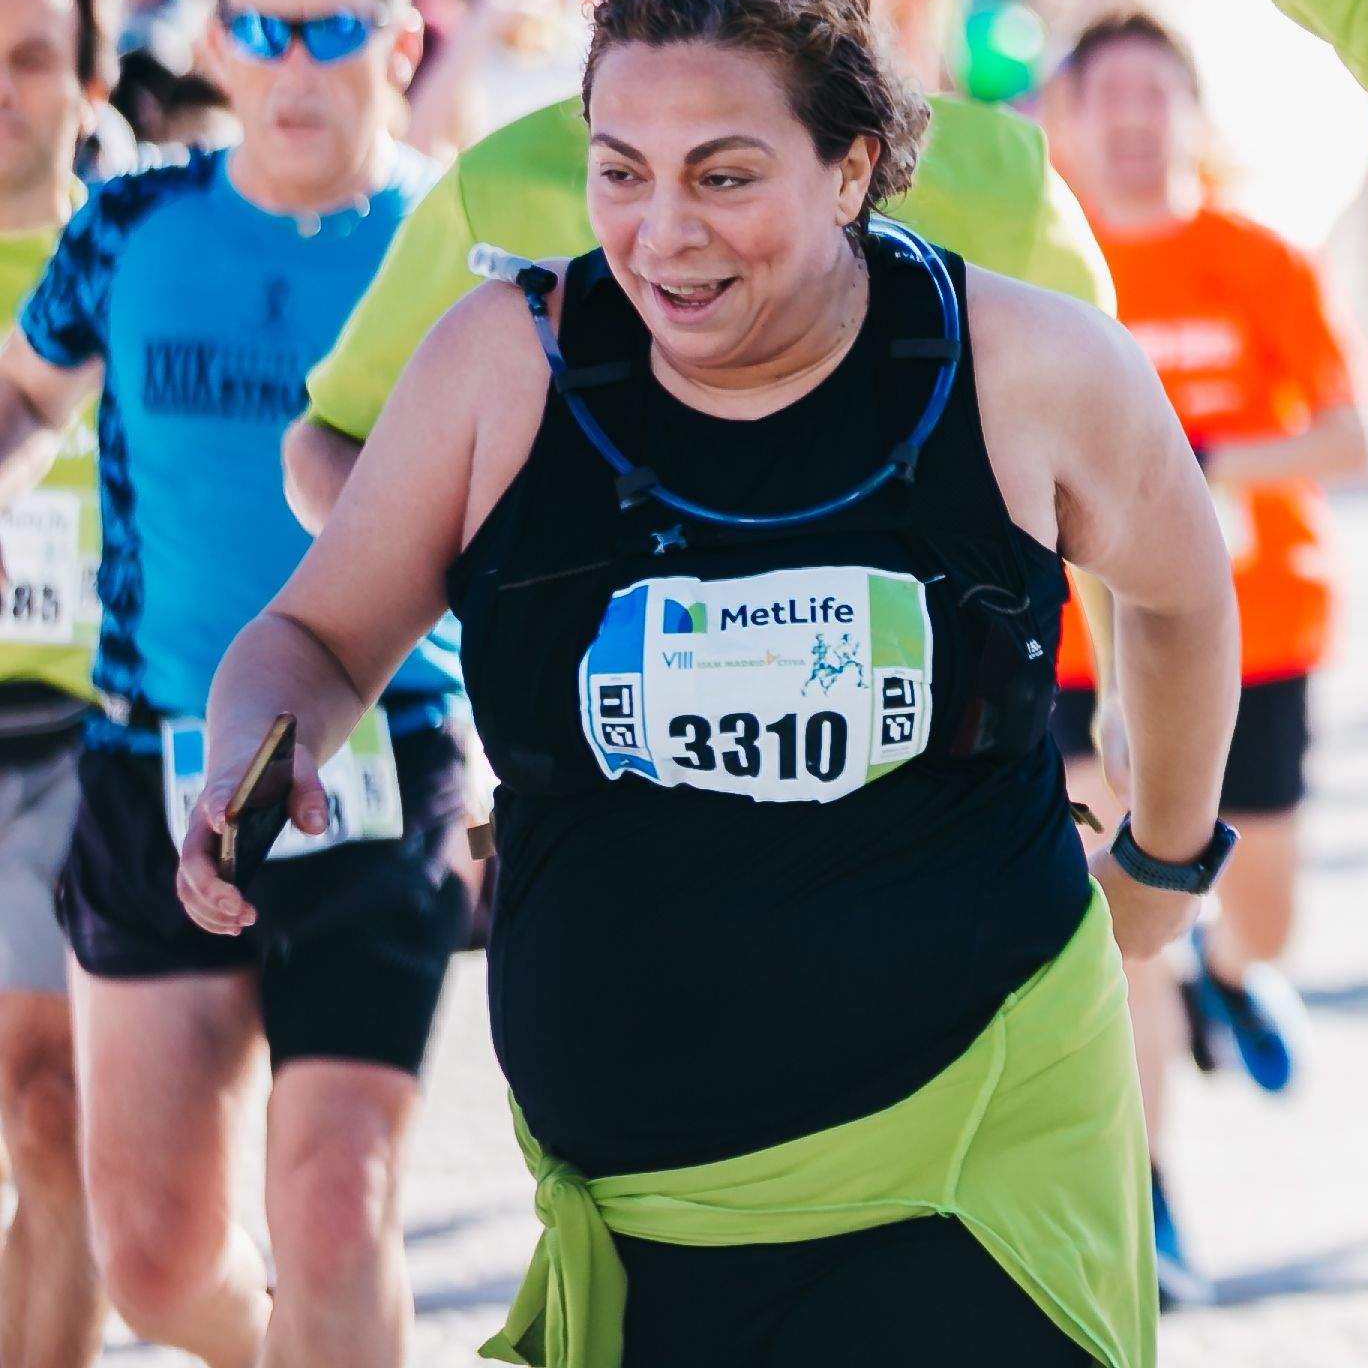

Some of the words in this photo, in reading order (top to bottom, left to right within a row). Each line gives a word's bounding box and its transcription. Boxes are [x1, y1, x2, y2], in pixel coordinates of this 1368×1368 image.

[720, 596, 855, 631] MetLife
[661, 650, 694, 670] VIII
[668, 710, 848, 783] 3310
